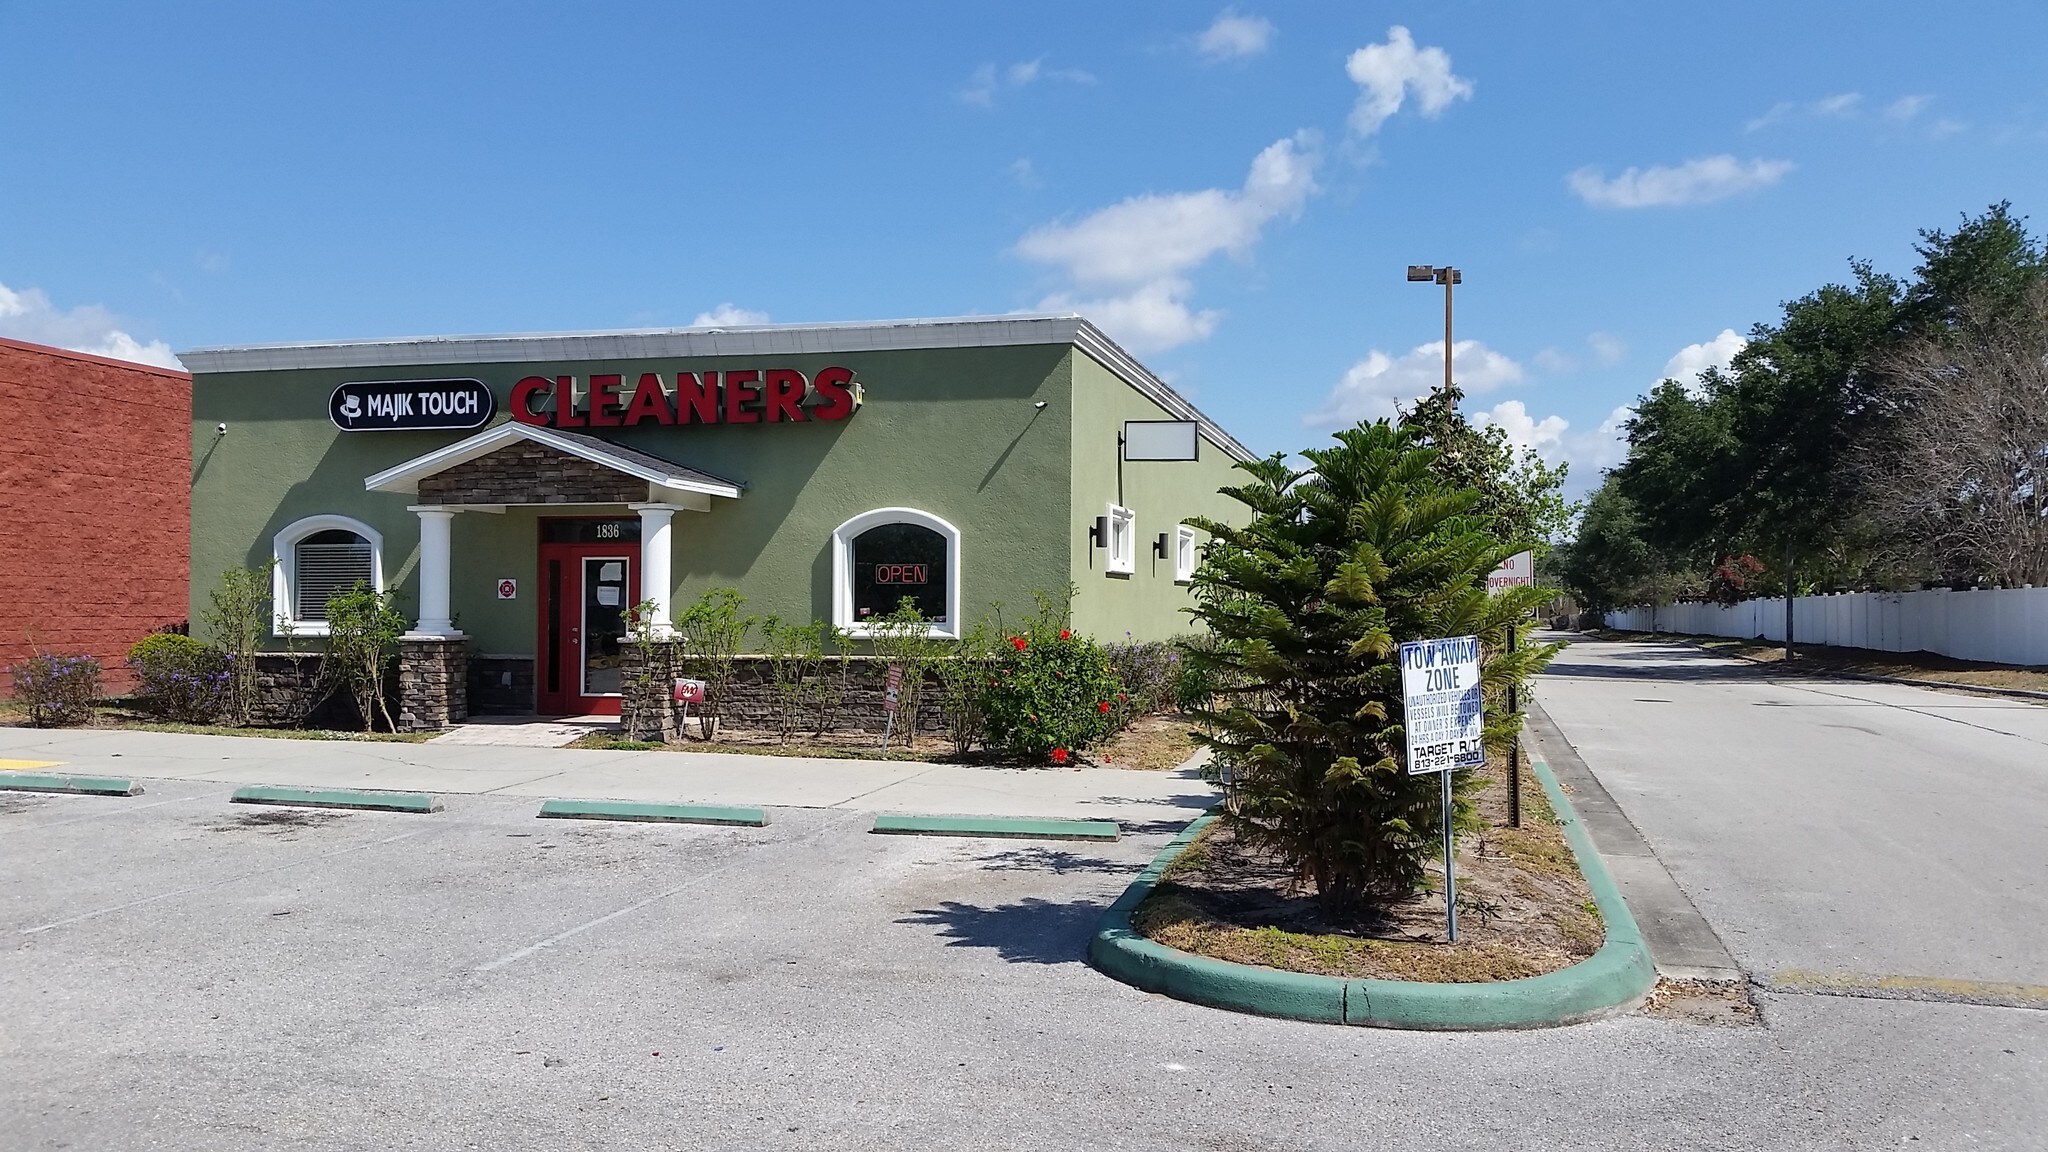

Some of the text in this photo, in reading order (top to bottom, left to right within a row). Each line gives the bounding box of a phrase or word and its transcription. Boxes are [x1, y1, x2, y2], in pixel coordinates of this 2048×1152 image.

[367, 391, 478, 422] MAJIK TOUCH
[510, 366, 859, 428] CLEANERS
[597, 524, 619, 538] 1836
[878, 565, 926, 582] OPEN
[1503, 559, 1514, 569] NO
[1489, 576, 1530, 588] OVERNIGHT
[1405, 641, 1473, 670] TOW AWAY
[1425, 667, 1460, 692] ZONE
[1408, 687, 1479, 707] UNAUTHORIZED VEHICLES OR
[1409, 701, 1478, 720] VESSELS WILL BE TOWED
[1414, 714, 1476, 733] AT OWNER'S EXPENSE
[1411, 734, 1418, 745] 24
[1419, 733, 1429, 744] HRS
[1430, 732, 1434, 743] A
[1450, 728, 1463, 739] DAYS
[1414, 739, 1478, 759] TARGET R/T
[1414, 751, 1479, 769] 813-221-6800
